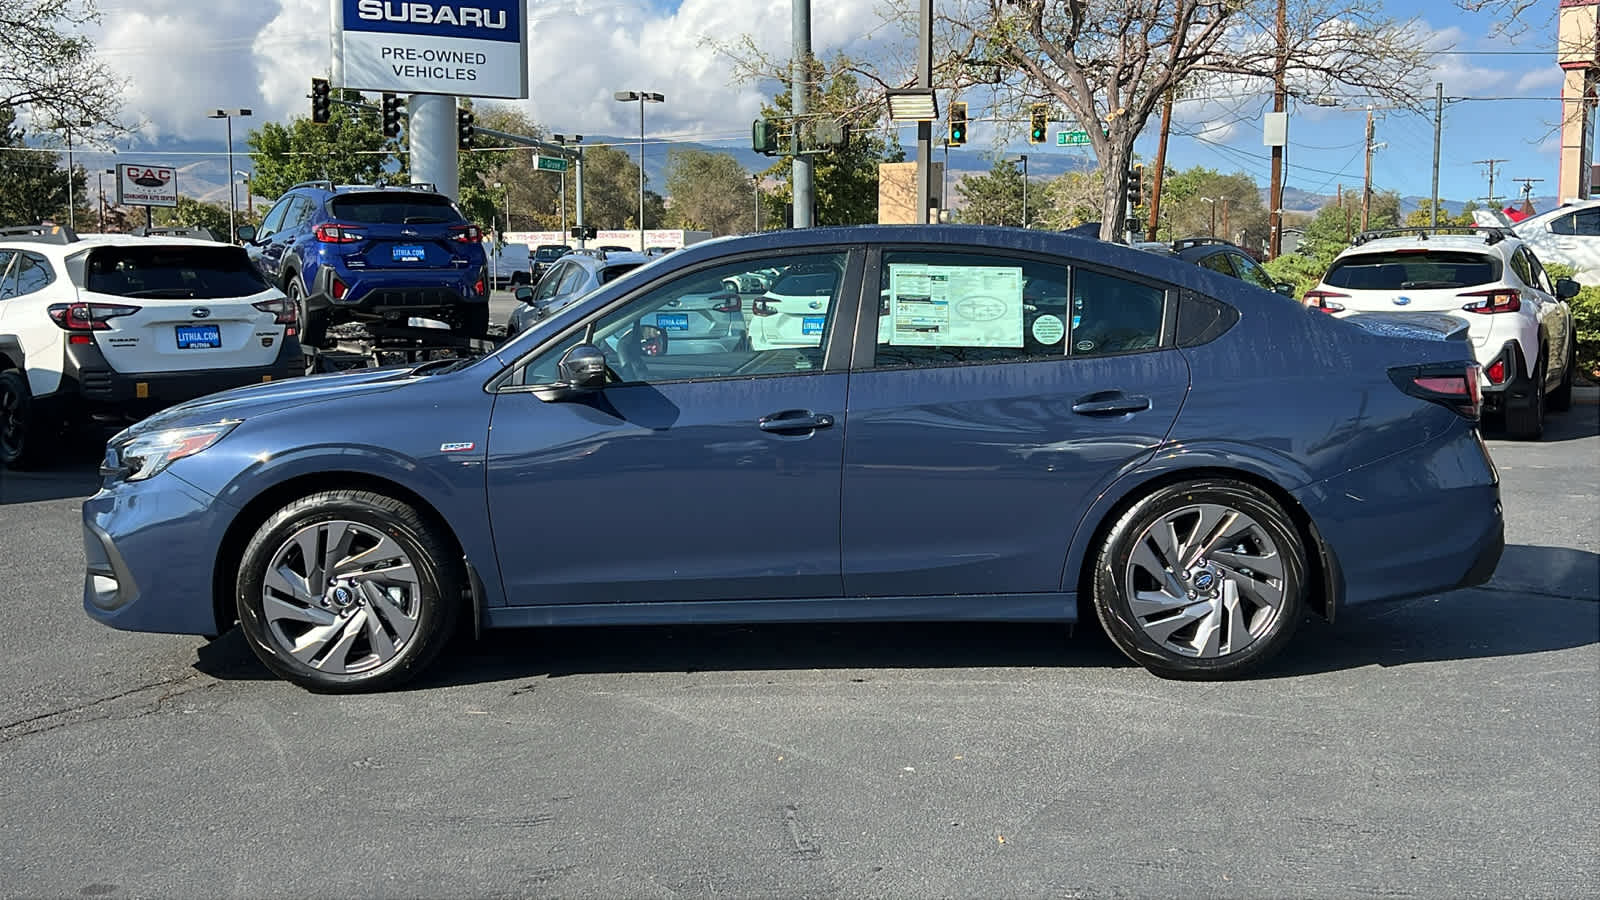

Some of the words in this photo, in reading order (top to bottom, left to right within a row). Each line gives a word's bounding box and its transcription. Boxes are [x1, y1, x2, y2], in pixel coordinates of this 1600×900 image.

[358, 0, 506, 29] SUBARU
[381, 47, 486, 65] PRE-OWNED
[392, 64, 477, 81] VEHICLES
[178, 332, 218, 342] LITHIA.COM
